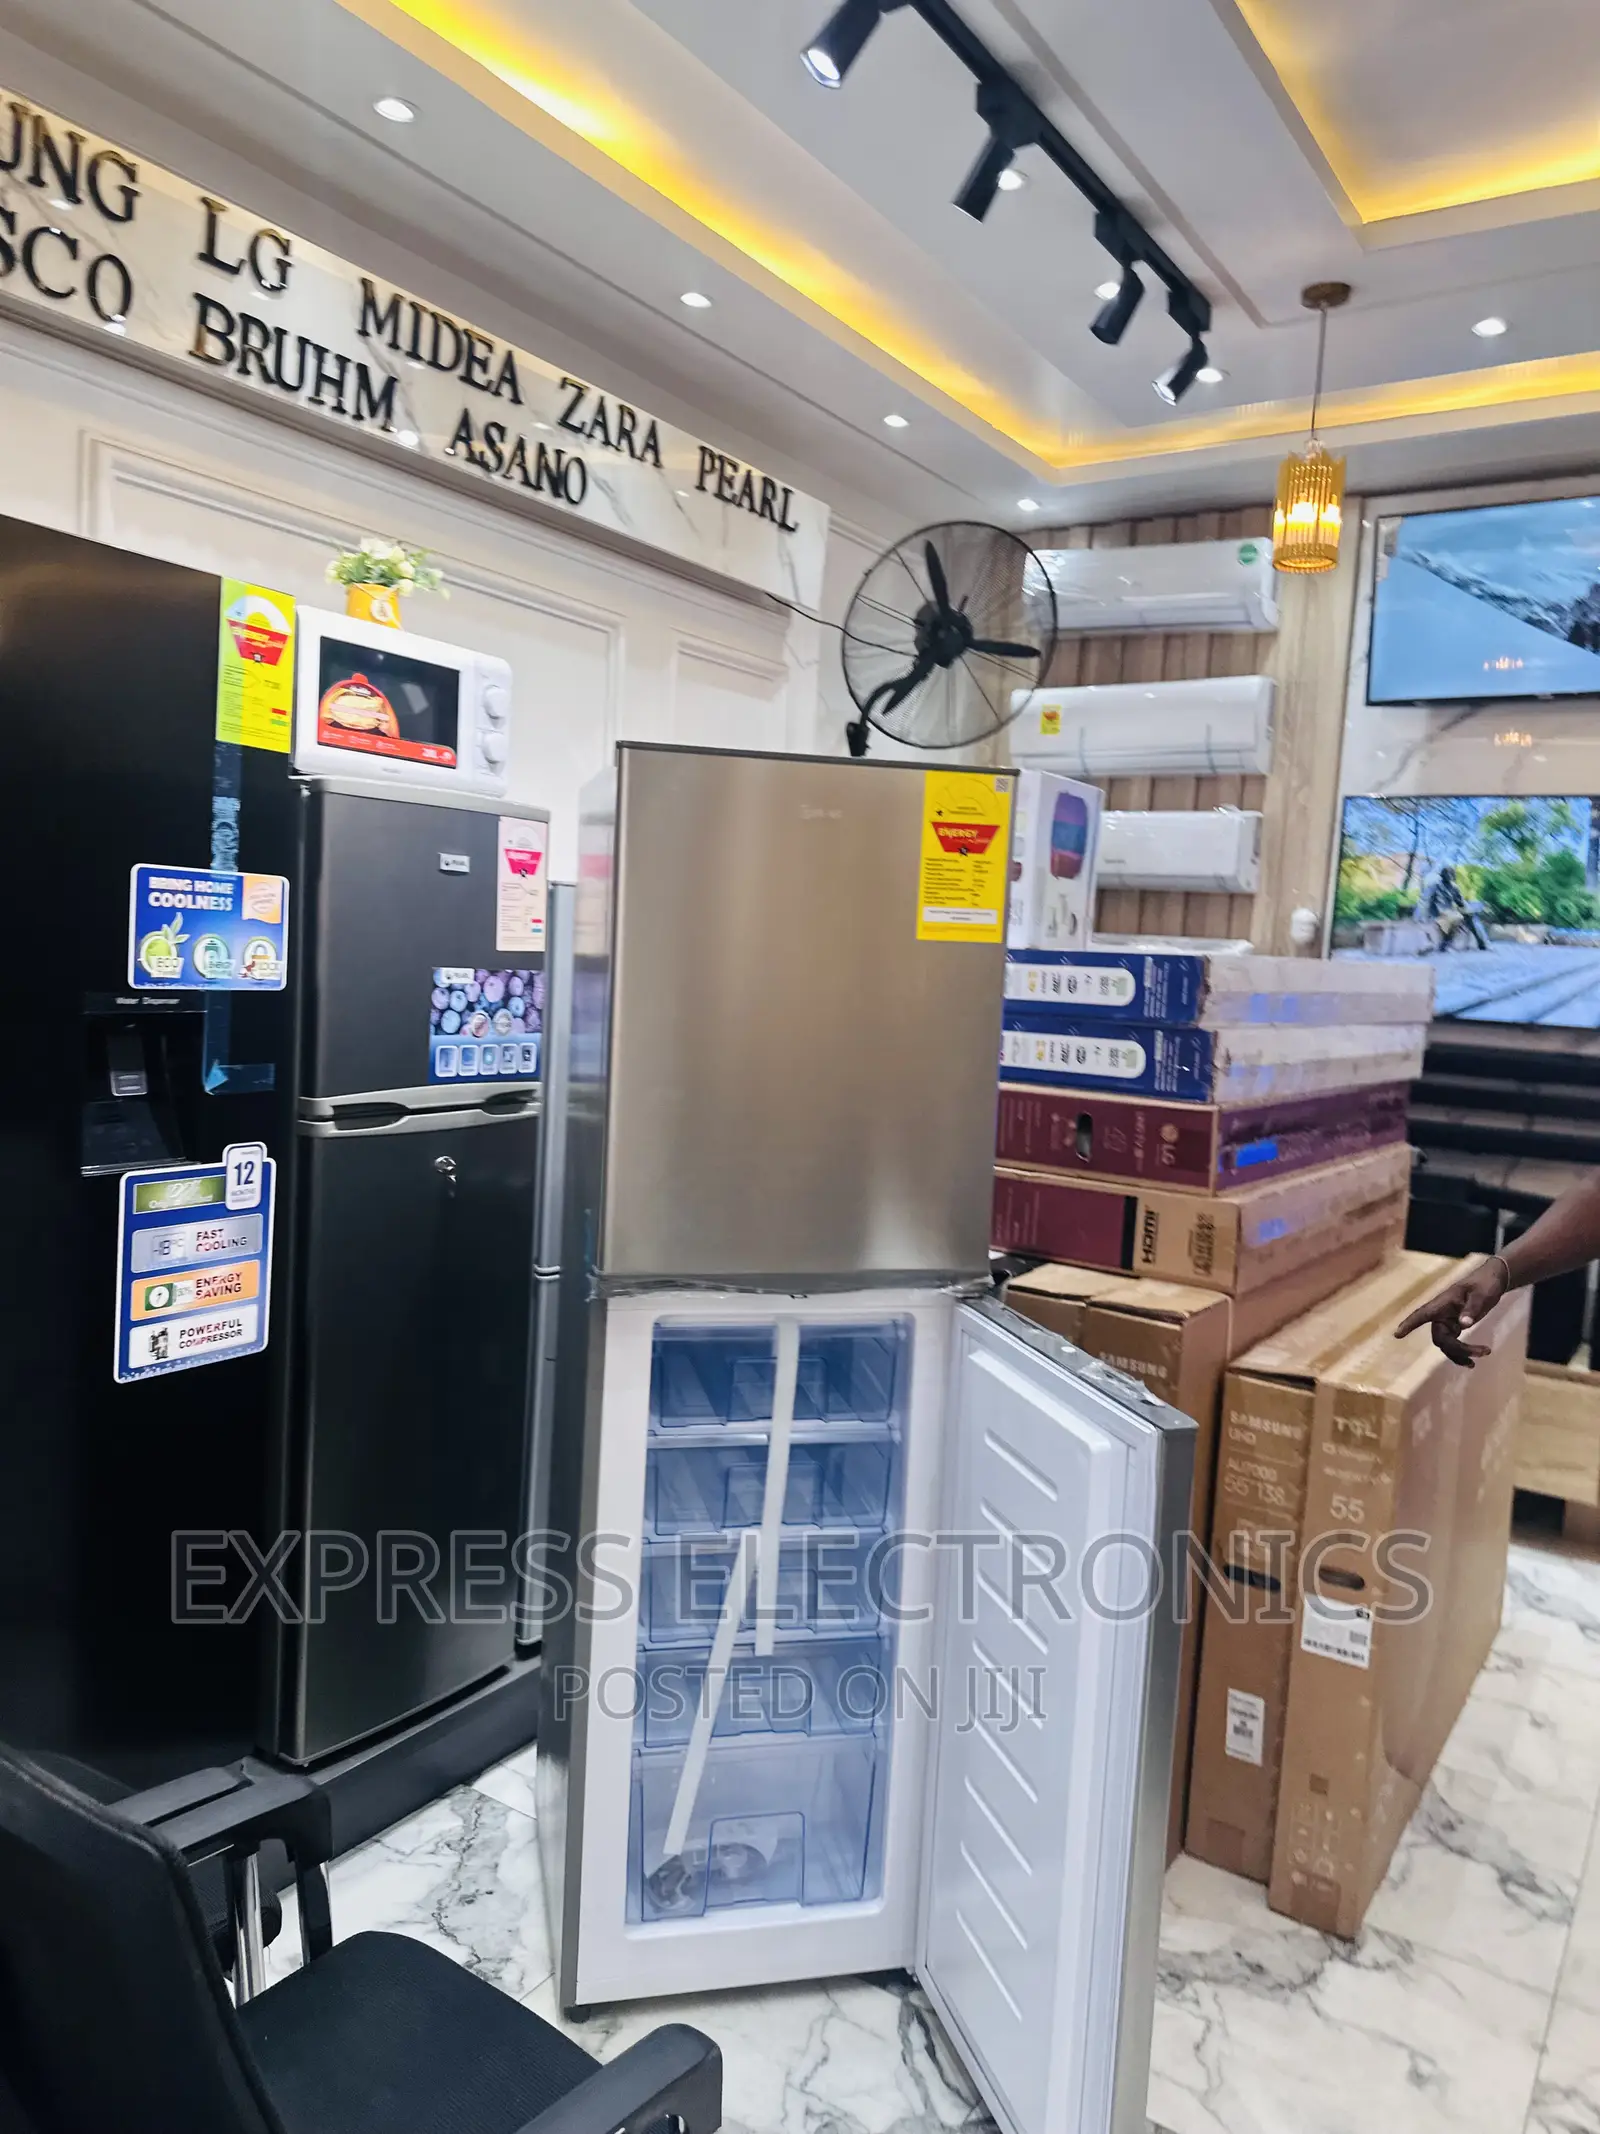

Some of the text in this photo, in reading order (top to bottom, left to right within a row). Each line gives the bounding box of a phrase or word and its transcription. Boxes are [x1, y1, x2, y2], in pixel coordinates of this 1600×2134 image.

[198, 196, 293, 292] LG
[357, 277, 523, 405] MIDEA
[557, 376, 664, 469] ZARA
[696, 444, 799, 532] PEARL
[189, 292, 399, 433] BRUHM
[446, 406, 588, 505] ASANO
[148, 876, 234, 895] BRING HOME
[148, 891, 233, 911] COOLNESS
[234, 1160, 255, 1186] 12
[196, 1228, 225, 1242] FAST
[196, 1236, 248, 1253] COOLING
[195, 1282, 242, 1300] SAVING
[196, 1272, 243, 1290] ENERGY
[178, 1328, 243, 1349] COMPRESSOR
[179, 1318, 243, 1339] POWERFUL
[1329, 1491, 1365, 1524] 55
